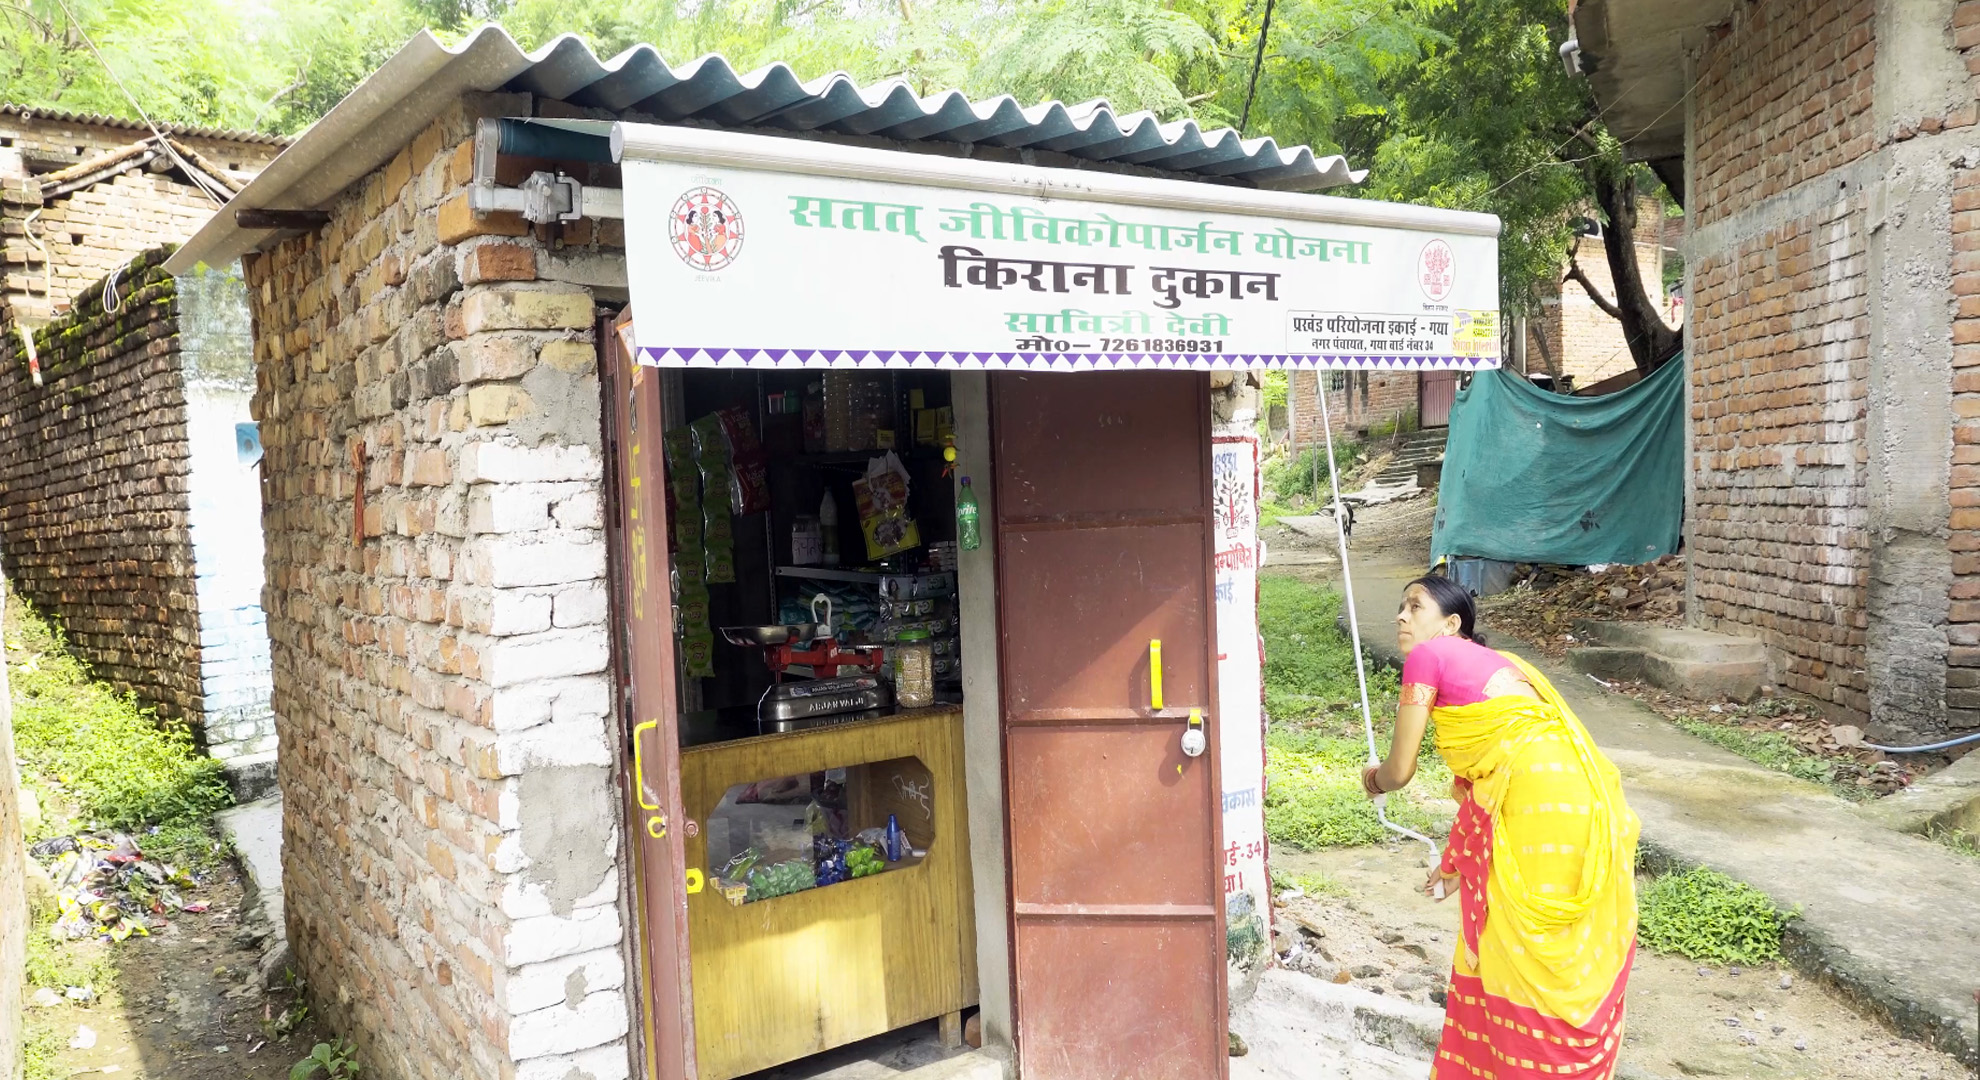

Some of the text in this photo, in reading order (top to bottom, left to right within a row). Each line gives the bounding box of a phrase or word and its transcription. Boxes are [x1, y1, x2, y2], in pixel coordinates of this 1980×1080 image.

[787, 195, 1373, 264] सतत् जीविकोपार्जन योजना
[694, 274, 722, 283] JEEVIKA
[938, 245, 1281, 309] किराना दुकान
[1004, 309, 1233, 337] सावित्री देवी
[1293, 314, 1323, 333] प्रखंड
[1326, 315, 1385, 335] परियोजना
[1388, 317, 1418, 336] इकाई
[1429, 321, 1449, 336] गया
[1100, 338, 1223, 353] 7261836931
[1312, 338, 1331, 350] नगर
[1370, 338, 1388, 351] गया
[1389, 338, 1405, 351] वार्ड
[1406, 338, 1424, 351] नंबर
[1425, 340, 1434, 351] 34
